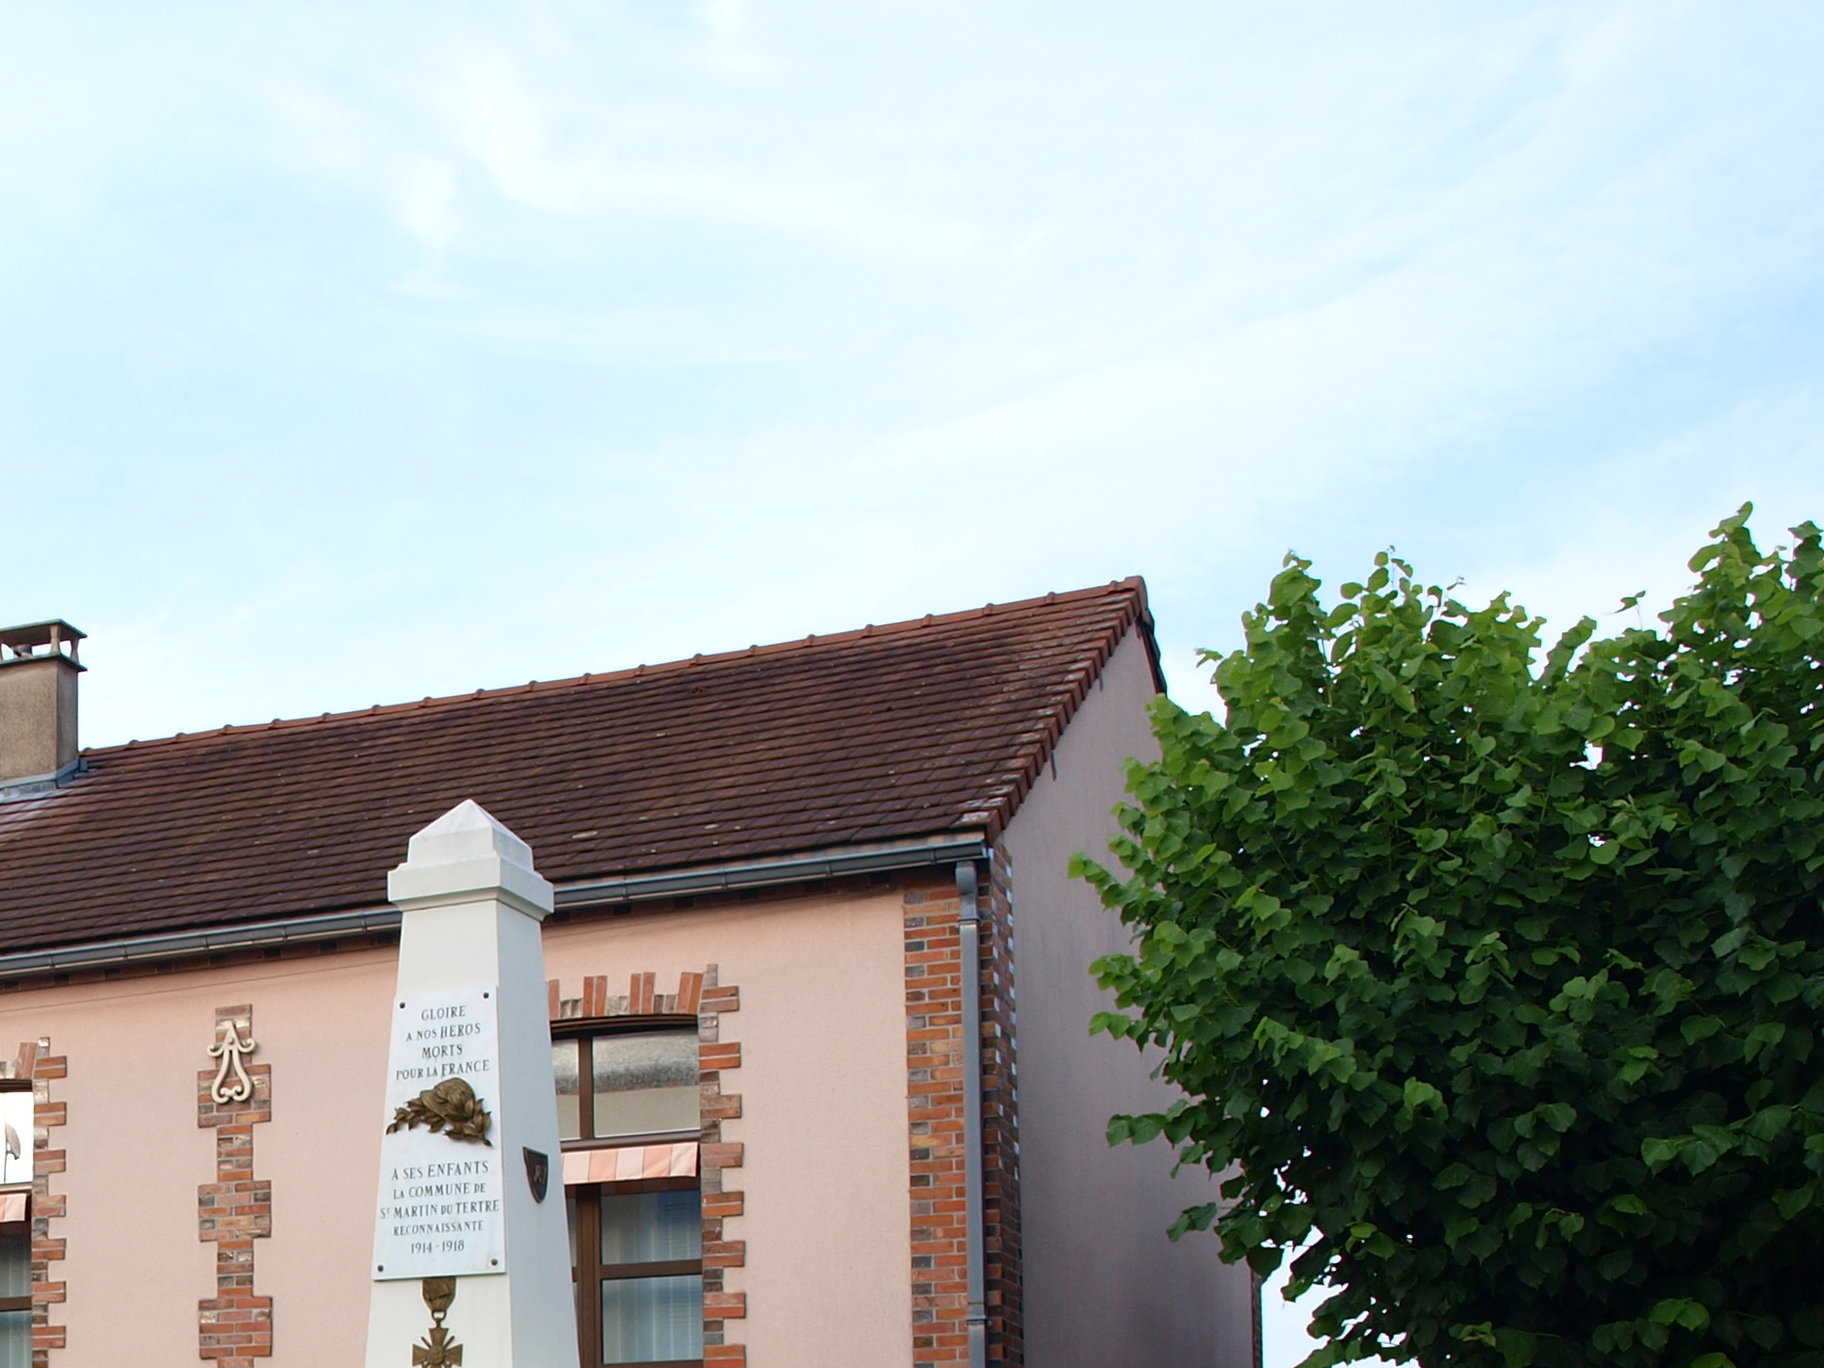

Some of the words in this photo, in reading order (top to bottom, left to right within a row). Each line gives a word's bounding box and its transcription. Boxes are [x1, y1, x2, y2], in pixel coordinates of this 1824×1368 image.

[421, 1005, 467, 1021] GLOIRE
[405, 1032, 413, 1042] A
[416, 1029, 437, 1040] NOS
[440, 1022, 481, 1039] HEROS
[422, 1044, 463, 1059] MORTS
[396, 1067, 424, 1080] POUR
[426, 1066, 438, 1077] LA
[441, 1060, 490, 1077] FRANCE
[392, 1168, 399, 1180] A
[403, 1167, 423, 1179] SES
[427, 1160, 489, 1178] ENFANTS
[393, 1189, 405, 1200] LA
[408, 1182, 471, 1198] COMMUNE
[474, 1183, 487, 1193] DE
[393, 1204, 438, 1219] MARTIN
[440, 1205, 454, 1215] DU
[456, 1200, 500, 1214] TERTRE
[393, 1220, 484, 1236] RECONNAISSANTE
